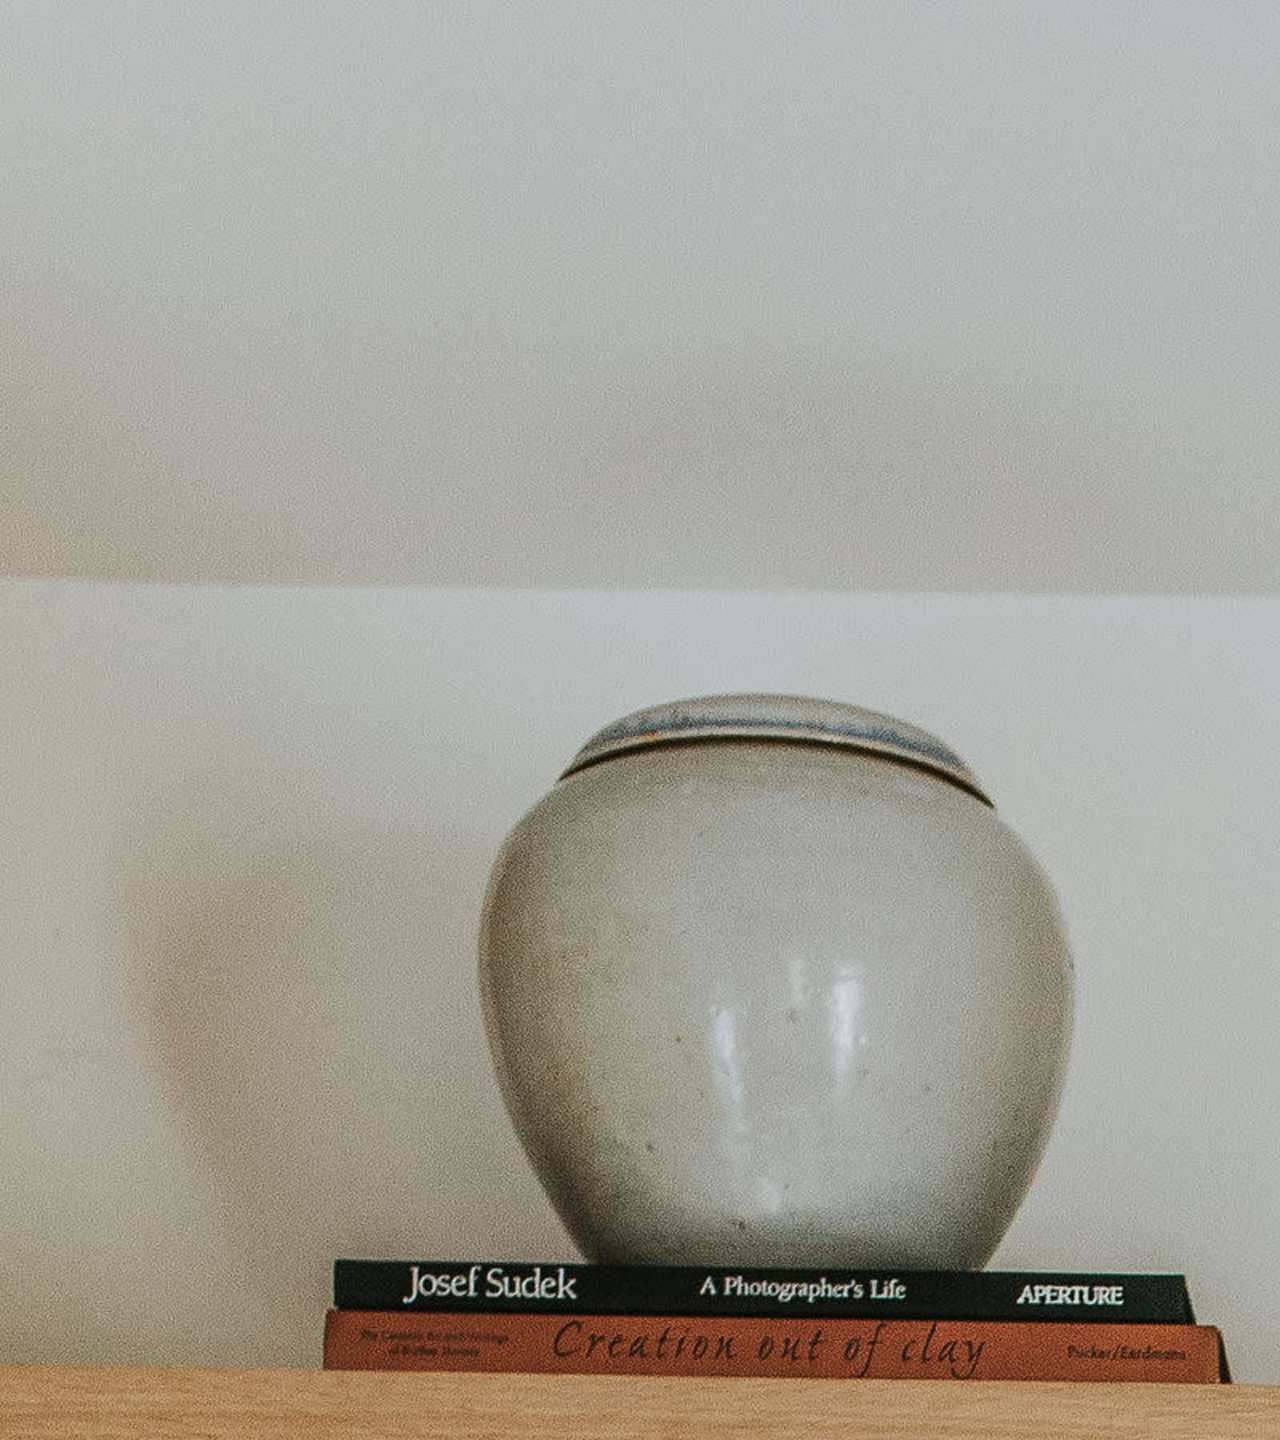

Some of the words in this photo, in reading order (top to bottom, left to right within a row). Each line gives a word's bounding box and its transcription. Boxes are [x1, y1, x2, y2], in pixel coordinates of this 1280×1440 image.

[402, 1267, 479, 1302] Josef
[485, 1268, 577, 1299] Sudek
[699, 1276, 716, 1296] A
[724, 1278, 864, 1303] Photographer's
[869, 1279, 907, 1299] Life
[1016, 1285, 1124, 1306] APERTURE
[552, 1320, 735, 1362] Creation
[758, 1329, 819, 1364] out
[844, 1320, 887, 1378] of
[902, 1320, 986, 1381] clay
